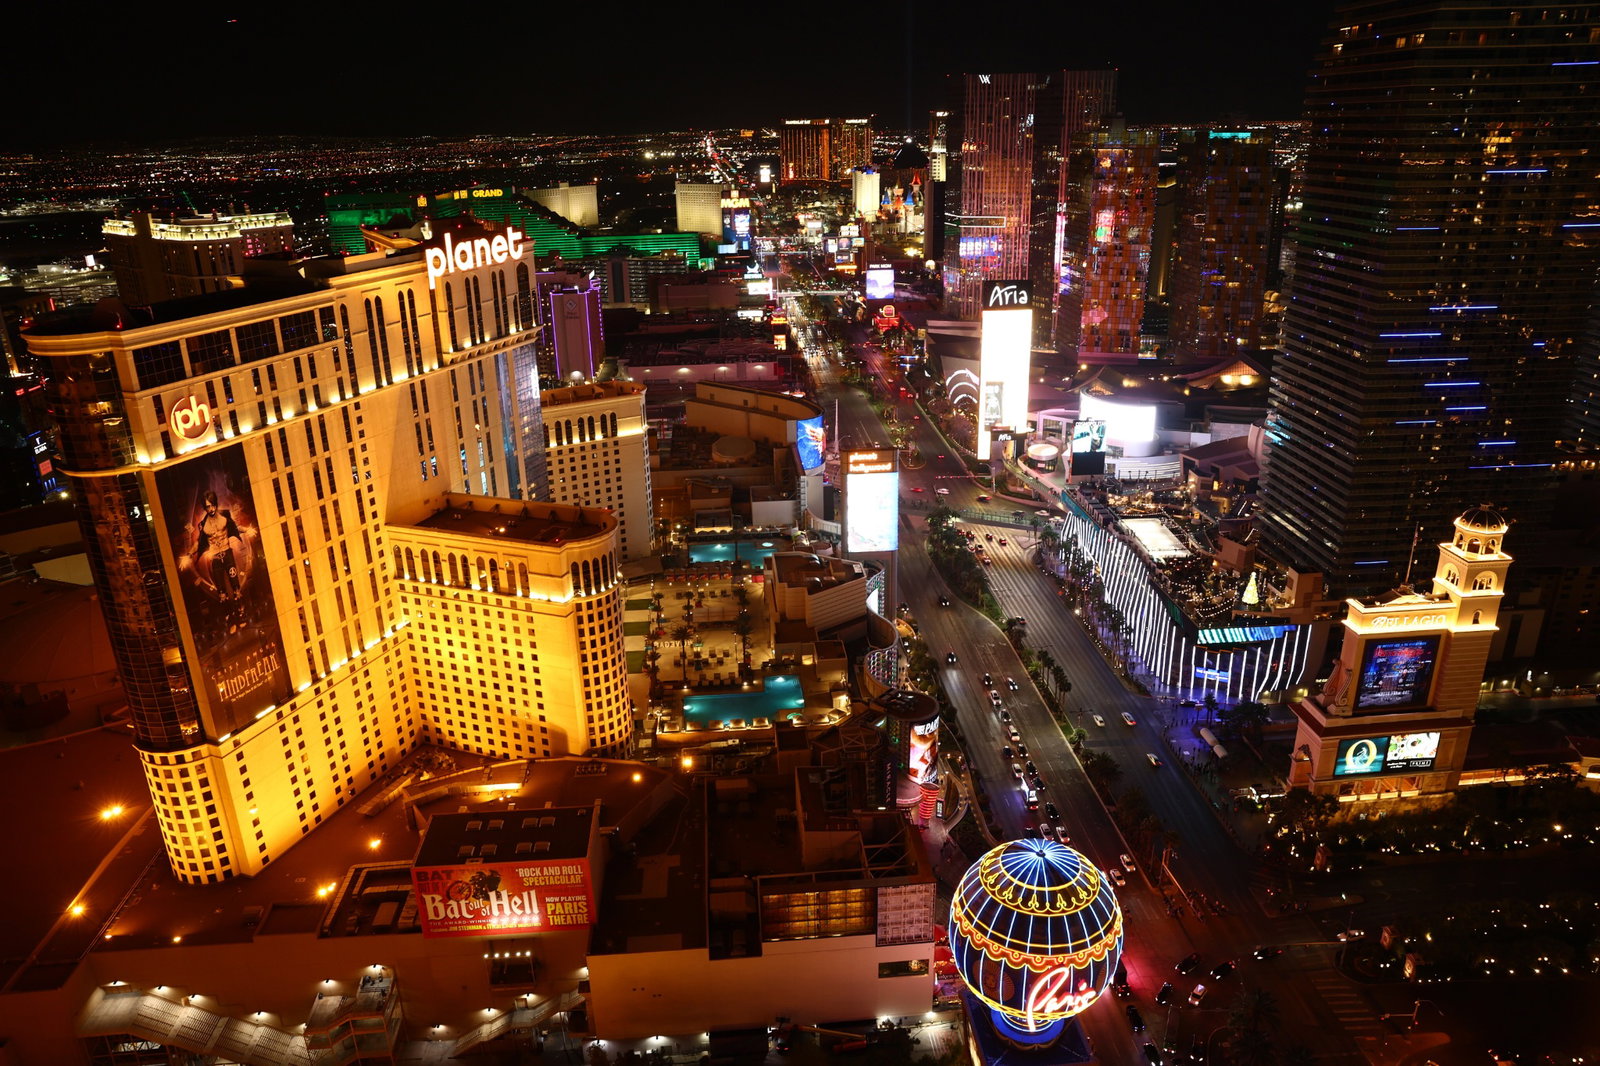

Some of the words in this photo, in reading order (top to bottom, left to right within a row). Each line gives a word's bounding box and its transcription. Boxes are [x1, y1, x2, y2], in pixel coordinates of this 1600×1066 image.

[472, 188, 503, 198] GRAND
[720, 198, 750, 209] MGM
[425, 226, 524, 290] planet
[989, 285, 1028, 307] Aria
[174, 395, 210, 437] ph
[849, 452, 878, 463] planet
[849, 462, 892, 473] hollywood
[1371, 614, 1447, 628] BELLAGIO
[217, 652, 281, 702] MINDFREAK
[543, 866, 561, 876] AND
[562, 865, 583, 875] ROLL
[422, 893, 474, 920] Bat
[469, 898, 485, 911] out
[481, 905, 490, 917] of
[488, 889, 541, 917] Hell
[546, 901, 588, 915] PARIS
[547, 913, 590, 926] THEATRE
[1027, 966, 1097, 1032] Paris
